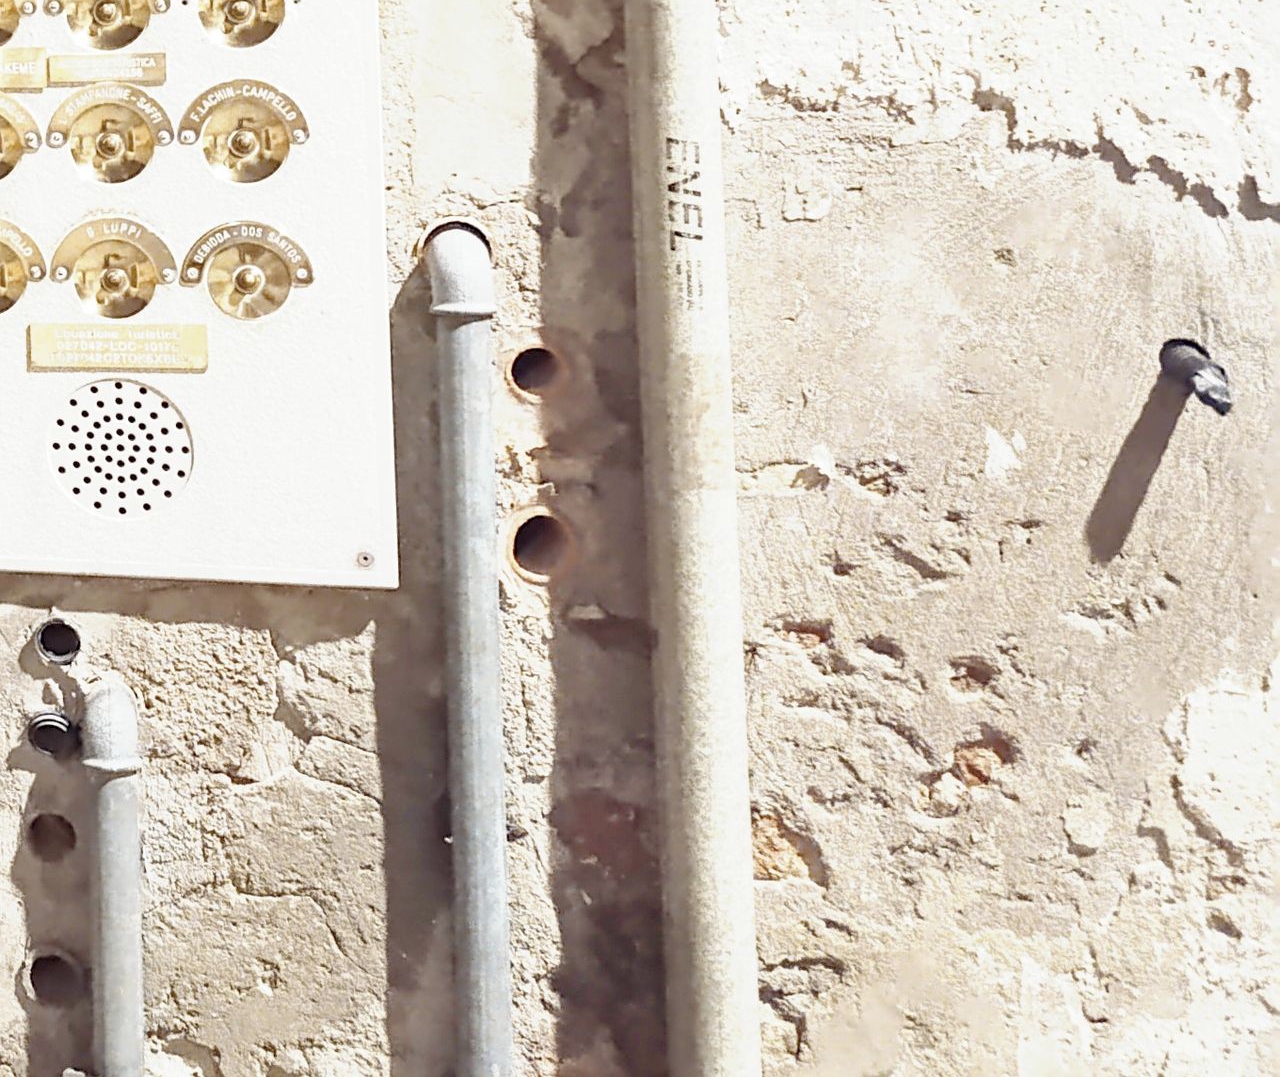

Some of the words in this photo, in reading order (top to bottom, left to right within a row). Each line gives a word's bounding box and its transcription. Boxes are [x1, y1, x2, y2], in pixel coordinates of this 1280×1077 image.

[666, 138, 703, 252] ENEL
[102, 222, 142, 239] LUPPI
[240, 225, 263, 238] DOS
[266, 231, 302, 264] SANTOS
